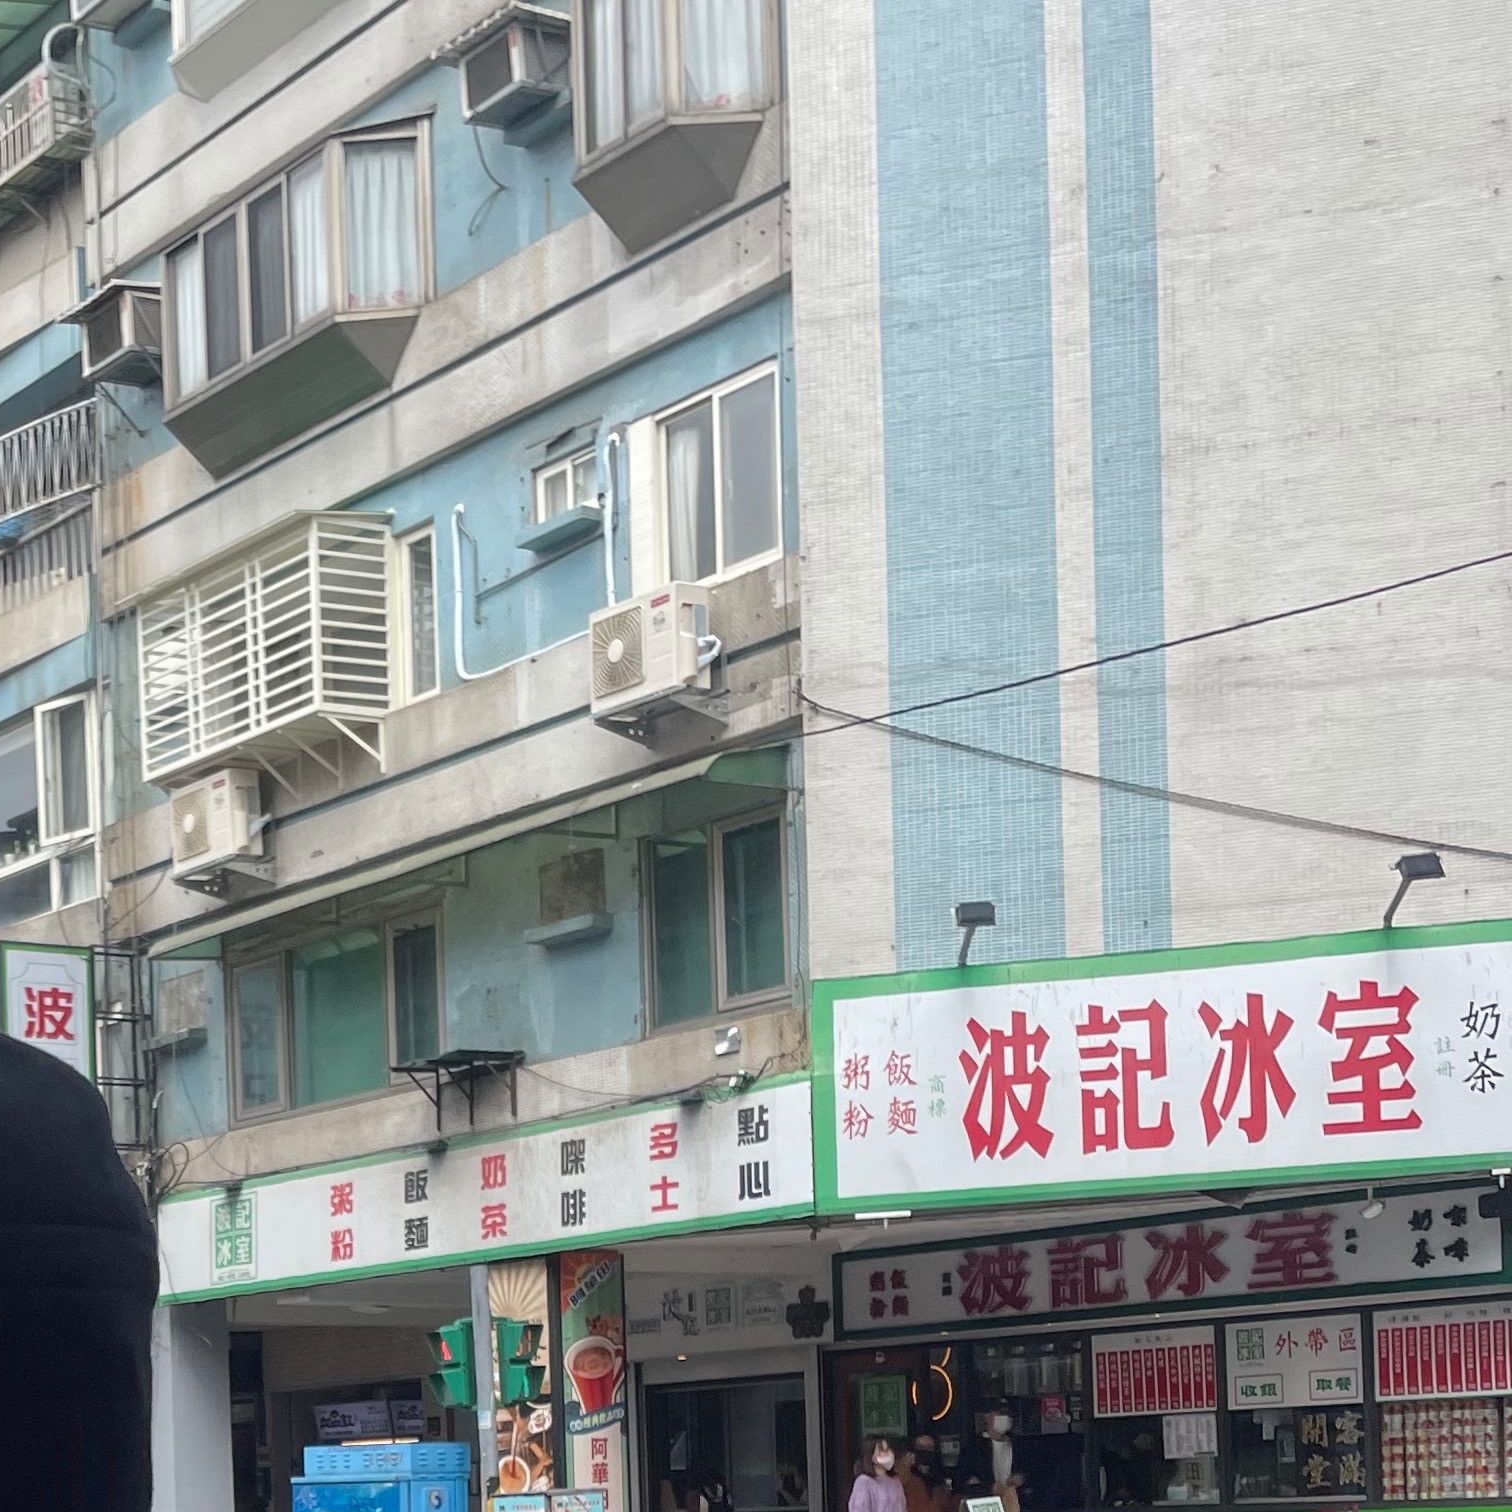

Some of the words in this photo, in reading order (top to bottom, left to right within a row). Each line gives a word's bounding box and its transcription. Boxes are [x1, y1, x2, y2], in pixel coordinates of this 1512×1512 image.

[24, 987, 75, 1040] 波
[1460, 1001, 1505, 1093] 奶茶
[842, 1053, 874, 1140] 粥粉
[883, 1050, 919, 1135] 飯麵
[959, 979, 1423, 1162] 波記冰室
[650, 1122, 679, 1213] 多士
[738, 1105, 771, 1201] 點心
[330, 1182, 354, 1262] 粥粉
[404, 1169, 428, 1251] 飯麵
[481, 1154, 507, 1240] 奶茶
[958, 1212, 1339, 1316] 波記冰室
[1275, 1327, 1357, 1358] 外帶區
[1315, 1377, 1352, 1392] 取餐
